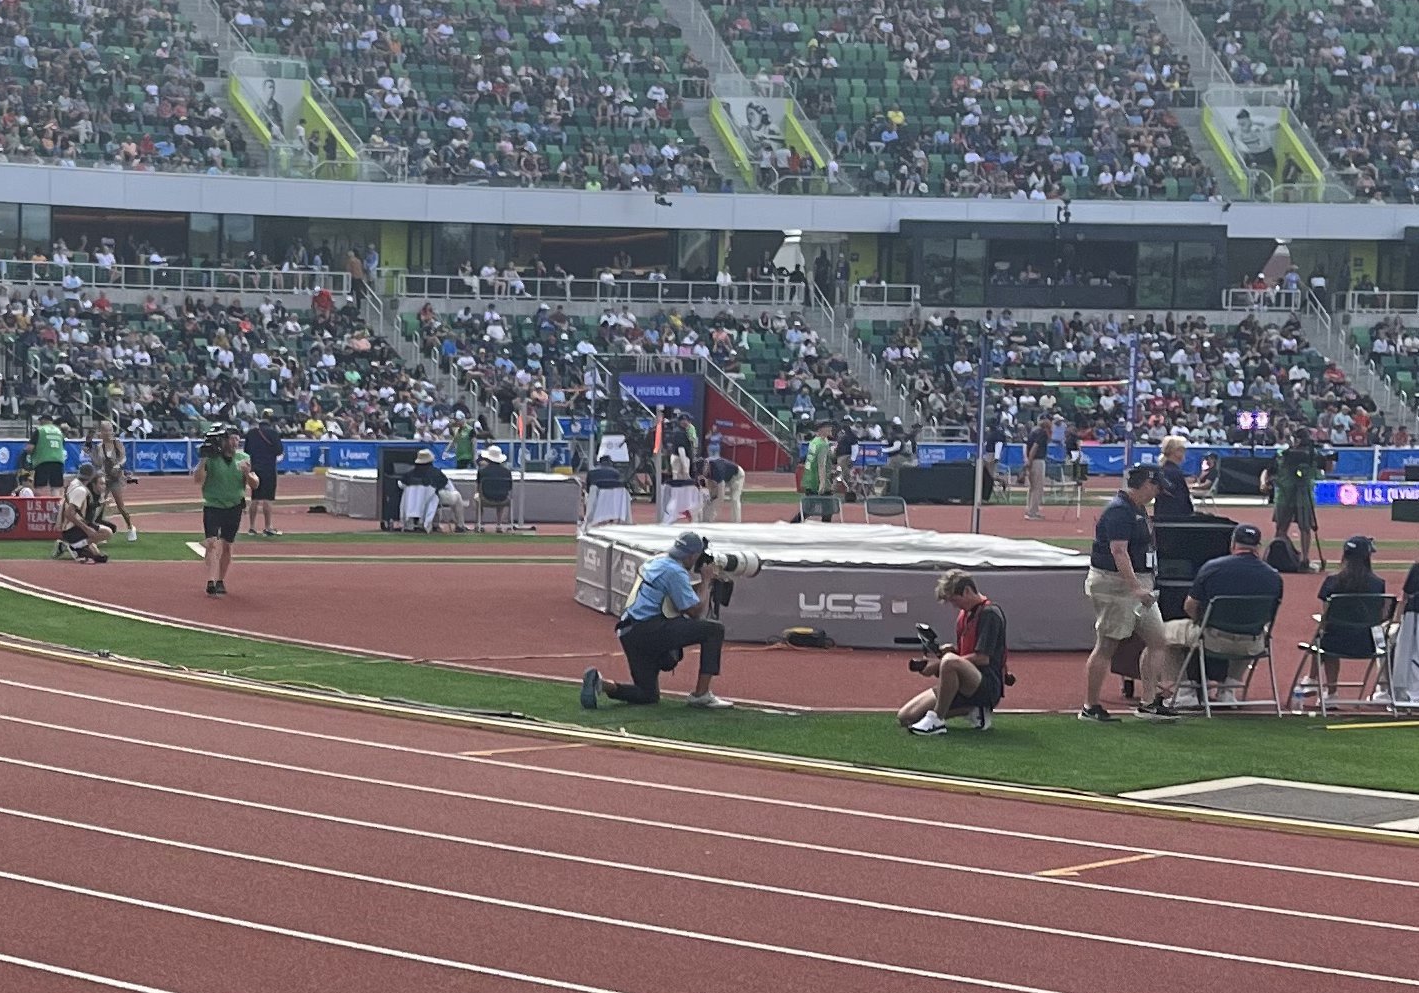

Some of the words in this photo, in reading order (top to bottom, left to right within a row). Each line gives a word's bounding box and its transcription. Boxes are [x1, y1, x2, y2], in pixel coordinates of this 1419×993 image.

[636, 385, 681, 397] HURDLES
[1364, 488, 1386, 502] U.S.
[799, 593, 881, 612] UCS
